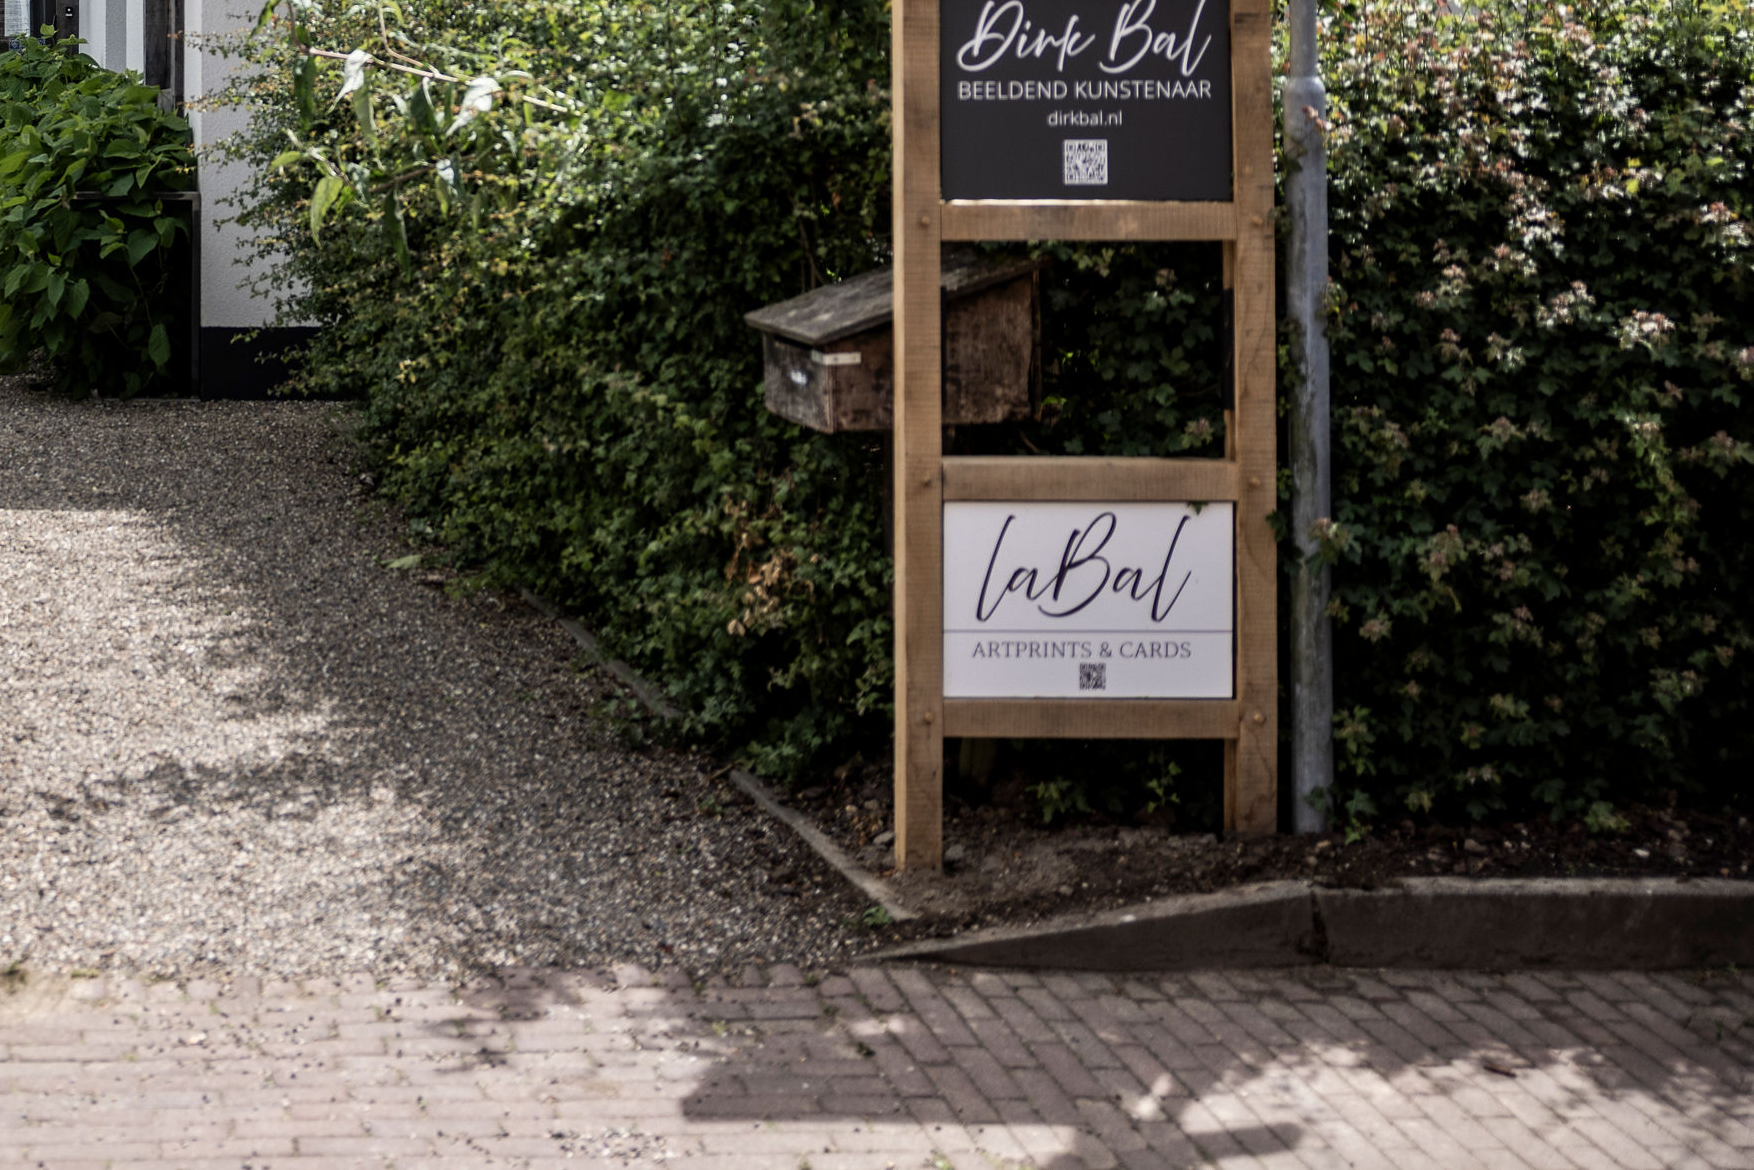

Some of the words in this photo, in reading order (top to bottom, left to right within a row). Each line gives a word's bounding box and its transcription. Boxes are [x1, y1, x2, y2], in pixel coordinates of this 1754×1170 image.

[956, 0, 1095, 72] Dirk
[958, 81, 1068, 101] BEELDEND
[1075, 80, 1212, 100] KUNSTENAAR
[1047, 110, 1123, 127] dirkbal.nl
[972, 641, 1092, 659] ARTPRINTS
[1099, 641, 1113, 659] &
[1119, 641, 1192, 659] CARDS
